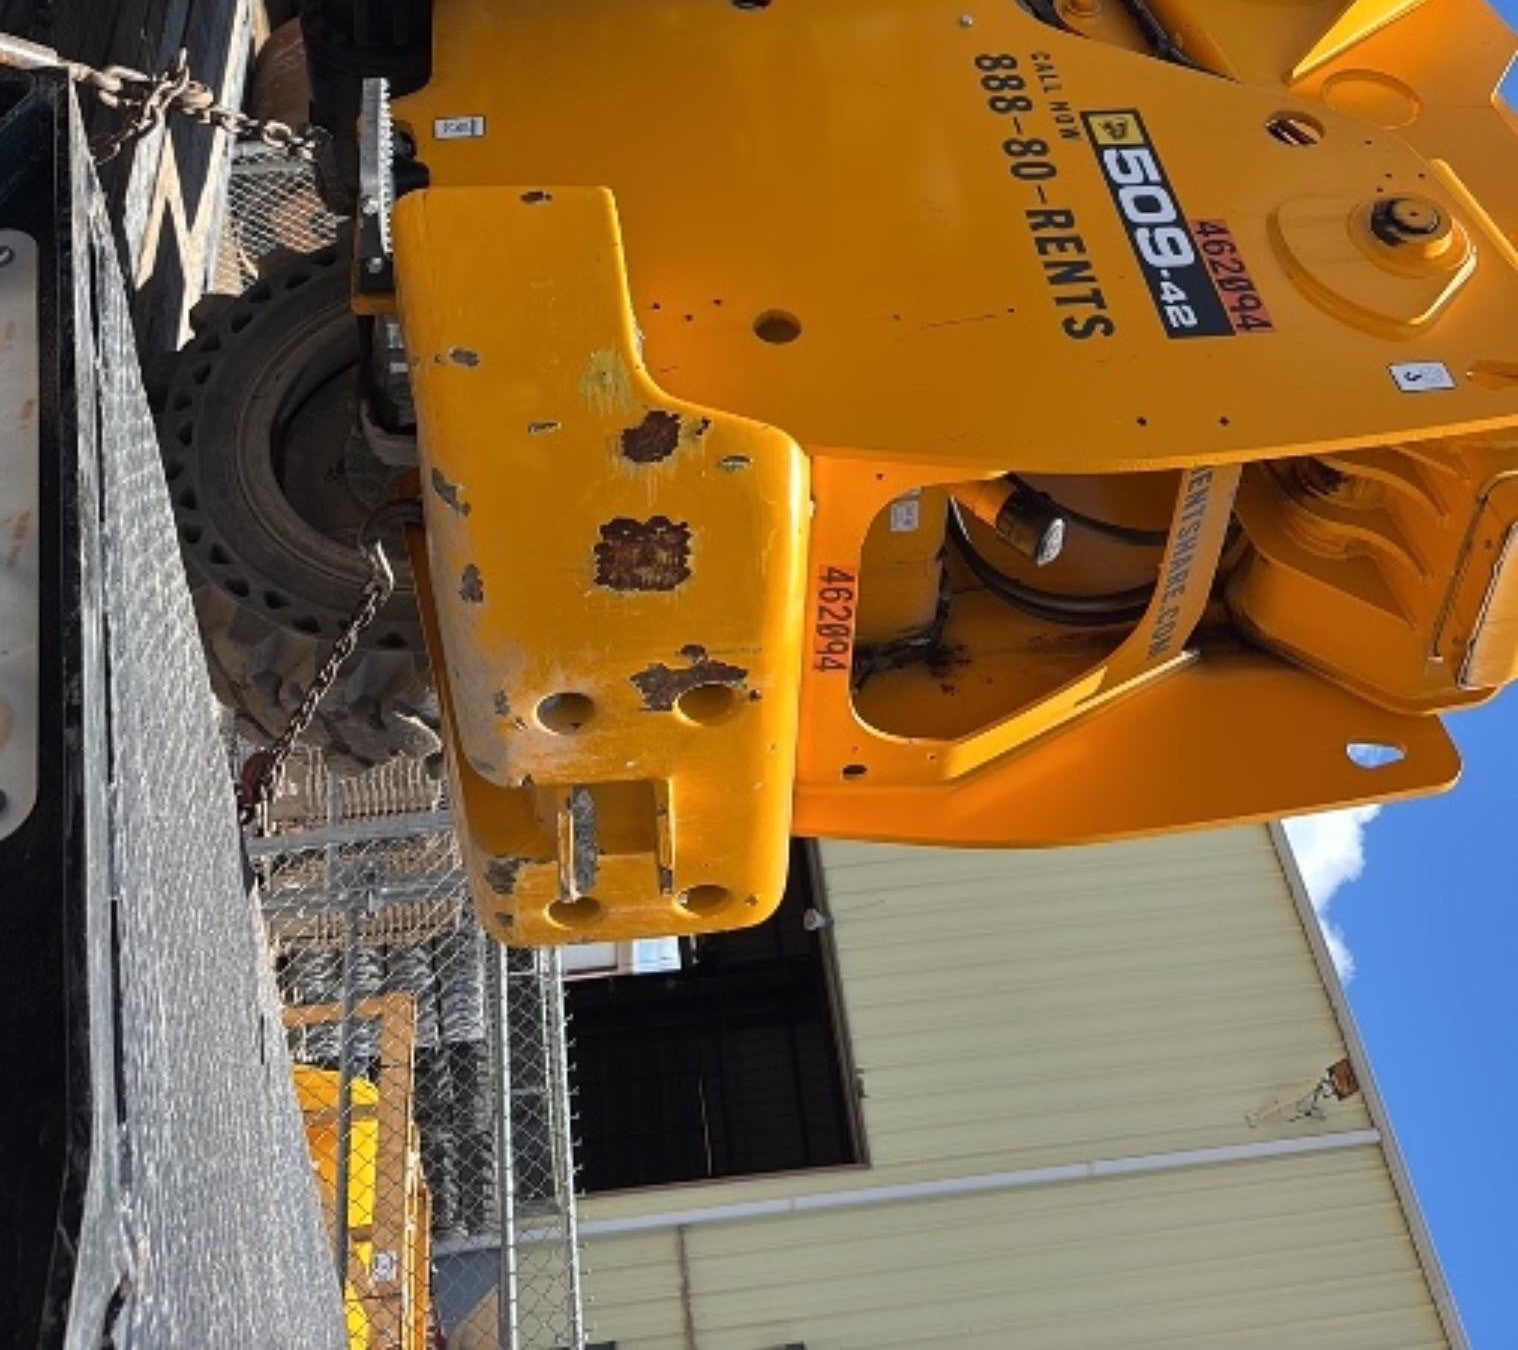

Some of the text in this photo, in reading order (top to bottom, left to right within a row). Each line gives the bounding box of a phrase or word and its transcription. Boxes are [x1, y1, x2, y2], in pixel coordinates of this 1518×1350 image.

[1030, 51, 1081, 139] CALL NOW
[974, 53, 1115, 340] 888-80-RENTS
[1195, 221, 1273, 331] 462094
[813, 567, 855, 672] 462094
